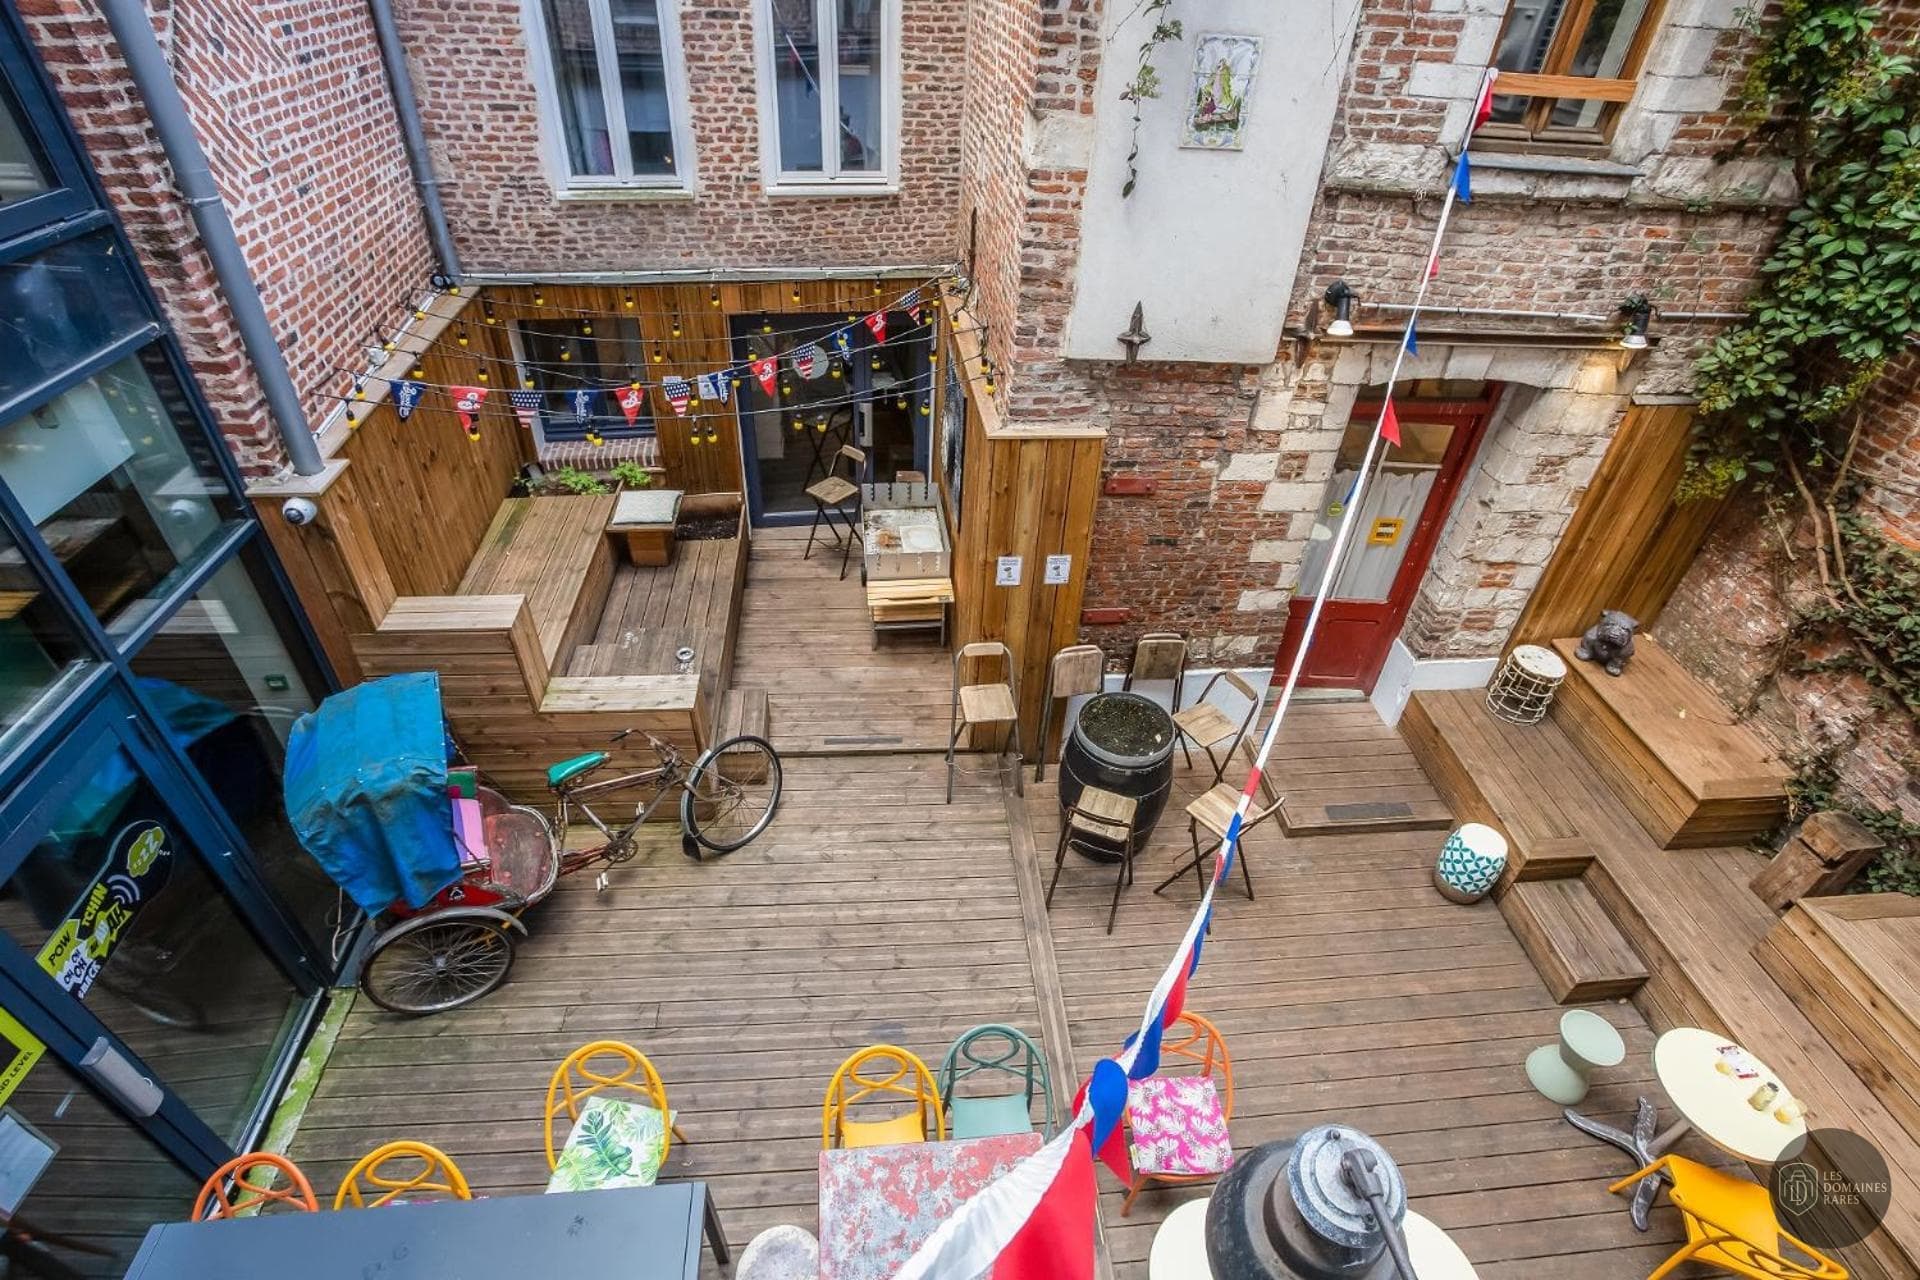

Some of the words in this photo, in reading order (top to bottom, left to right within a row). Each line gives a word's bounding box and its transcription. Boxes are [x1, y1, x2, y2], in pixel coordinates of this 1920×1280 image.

[81, 882, 108, 927] TCHIN
[48, 931, 71, 966] POW
[74, 958, 87, 978] OH
[10, 1051, 33, 1077] LEVEL
